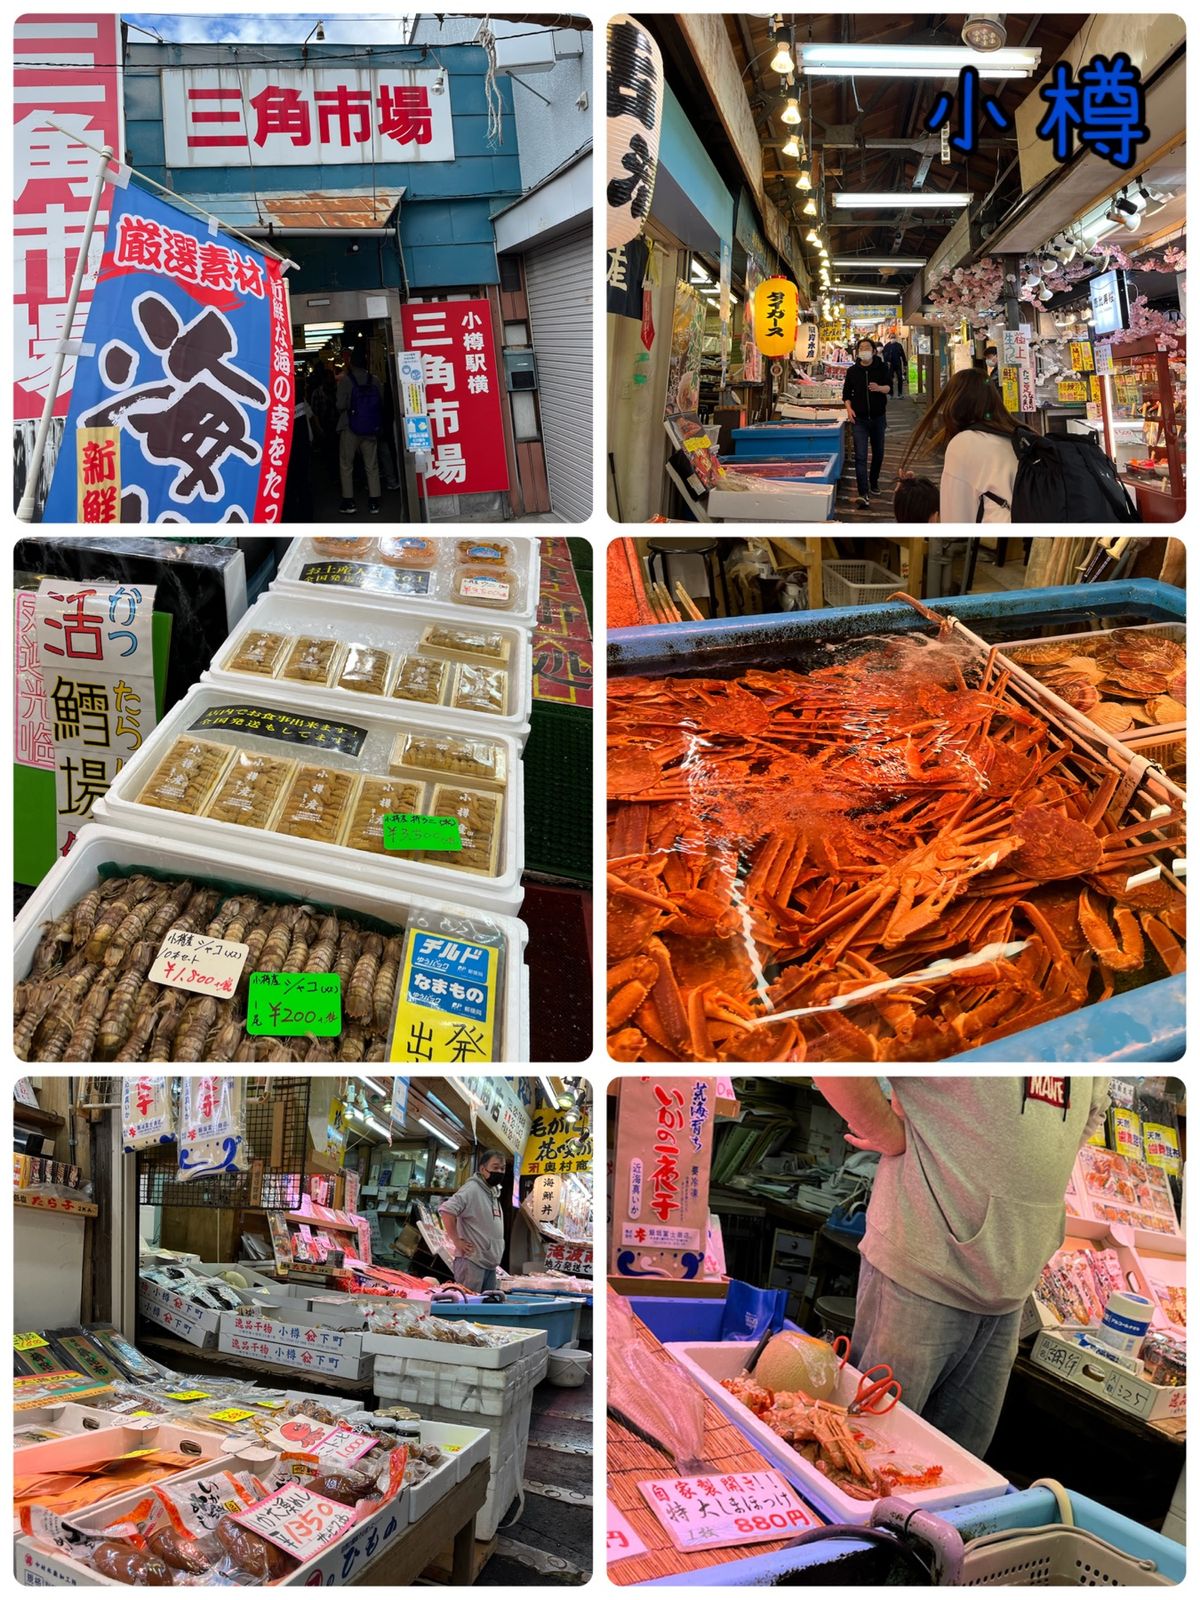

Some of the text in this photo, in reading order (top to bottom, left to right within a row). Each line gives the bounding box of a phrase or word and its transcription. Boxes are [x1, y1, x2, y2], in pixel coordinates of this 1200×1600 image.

[187, 85, 433, 149] 三角市場
[114, 216, 265, 298] 厳選素材
[766, 292, 785, 337] タイガース
[461, 311, 490, 395] 小樽駅横
[44, 588, 111, 857] 活鱈場
[415, 956, 450, 969] ゆうパック
[419, 938, 483, 964] チルド
[414, 973, 484, 1004] なまもの
[650, 1085, 685, 1222] いかの一夜干
[540, 1177, 555, 1216] 海鮮丼
[631, 1162, 642, 1216] 近海真いか
[231, 1338, 270, 1355] 逸品干物
[274, 1348, 297, 1361] 小樽
[316, 1354, 340, 1369] 下町
[234, 1317, 273, 1334] 逸品干物
[278, 1326, 301, 1339] 小樽
[320, 1332, 345, 1348] 下町
[734, 1508, 811, 1534] 880円
